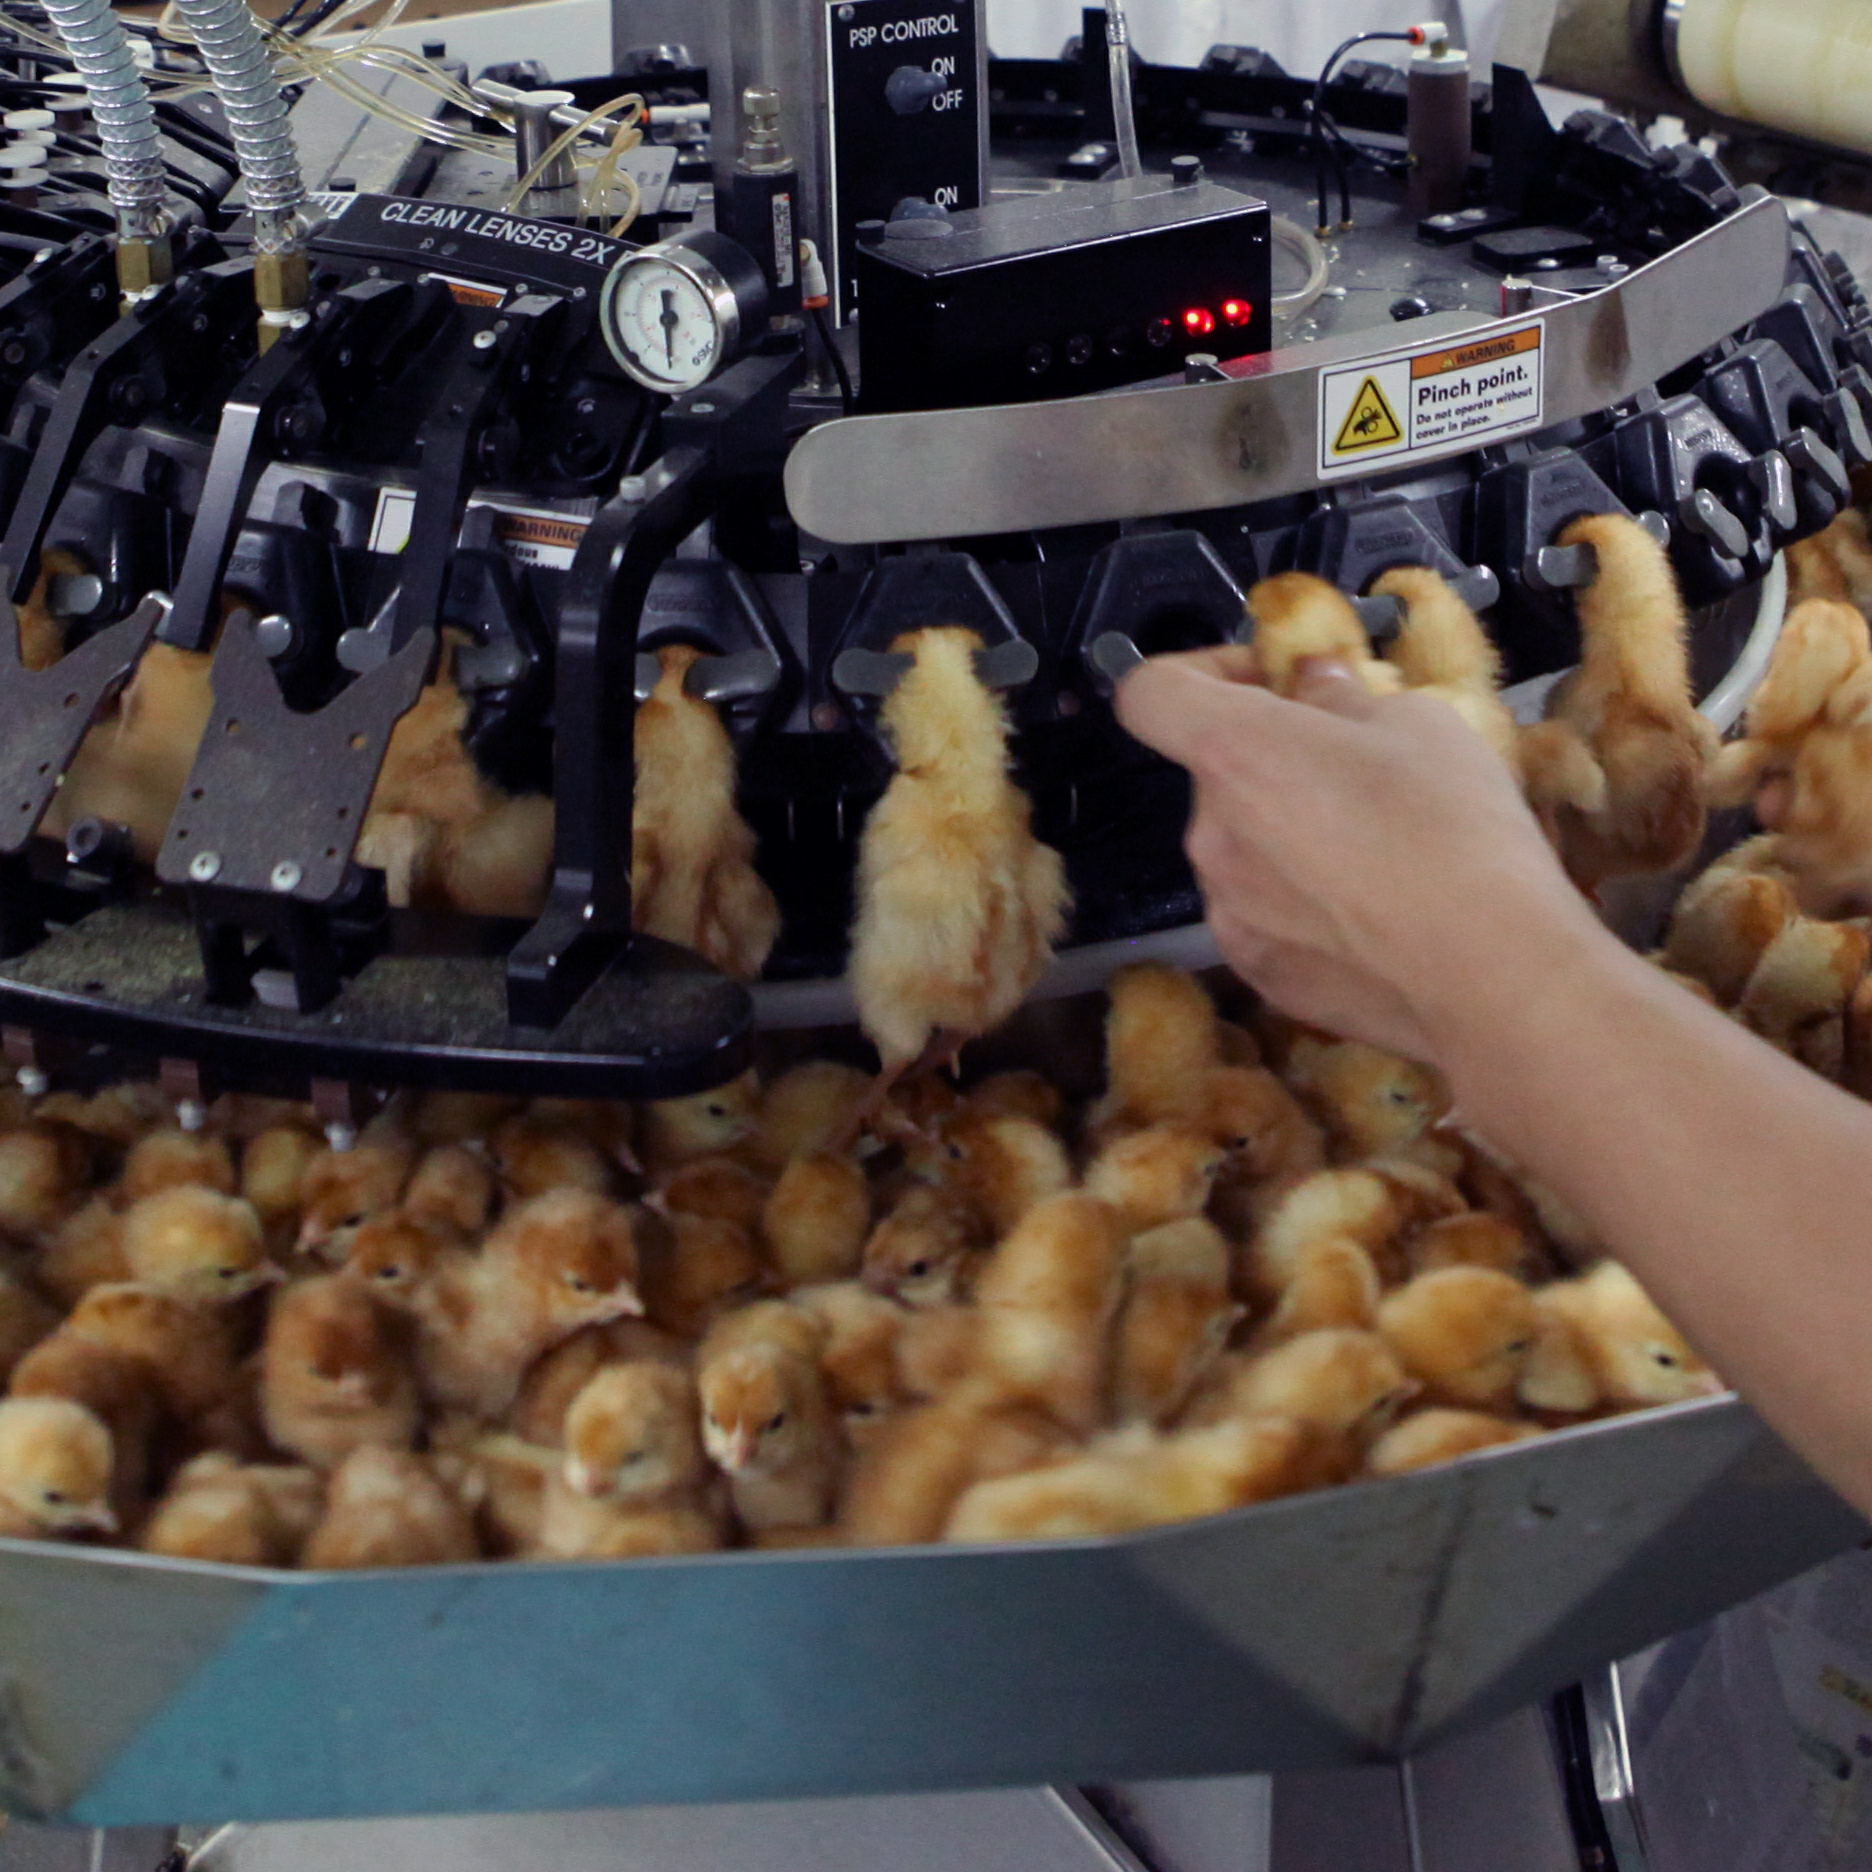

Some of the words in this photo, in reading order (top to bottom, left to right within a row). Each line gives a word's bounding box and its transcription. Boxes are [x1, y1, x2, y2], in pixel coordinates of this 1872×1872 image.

[849, 25, 877, 48] PSP
[881, 14, 959, 42] CONTROL
[931, 57, 955, 77] ON
[931, 89, 963, 112] OFF
[934, 185, 958, 206] ON
[380, 202, 468, 231] CLEAN
[463, 210, 573, 254] LENSES
[570, 239, 616, 265] 2X
[1455, 338, 1516, 364] WARNING
[1418, 381, 1471, 406] Pinch
[1477, 365, 1528, 395] point.
[1416, 413, 1431, 425] Do
[1434, 408, 1452, 420] not
[1455, 398, 1494, 417] operate
[1496, 387, 1533, 405] without
[1416, 426, 1445, 439] cover
[1448, 421, 1458, 432] in
[1461, 414, 1491, 431] place.
